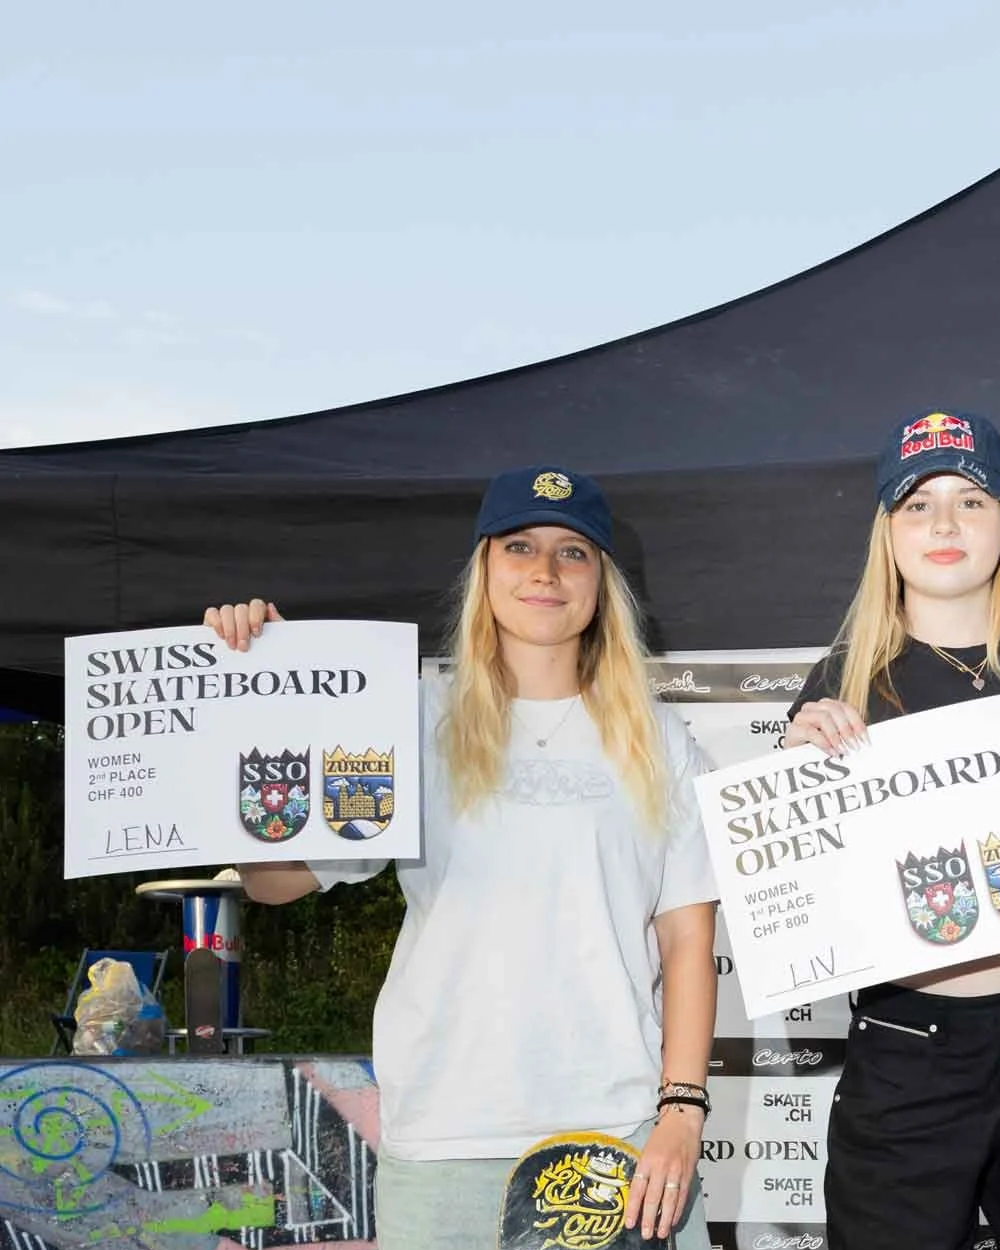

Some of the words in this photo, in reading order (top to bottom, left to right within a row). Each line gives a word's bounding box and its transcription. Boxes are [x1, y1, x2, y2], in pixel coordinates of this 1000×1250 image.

[901, 432, 936, 460] Red
[937, 431, 975, 453] Bull
[87, 642, 217, 677] SWISS
[87, 669, 367, 709] SKATEBOARD
[740, 674, 806, 692] Cert
[87, 706, 196, 741] OPEN
[751, 720, 790, 734] SKAT
[87, 752, 141, 769] WOMEN
[110, 768, 157, 781] PLACE
[243, 761, 307, 782] SSO
[719, 753, 852, 813] SWISS
[88, 789, 116, 802] CHF
[119, 786, 143, 799] 400
[104, 823, 185, 855] LENA
[735, 822, 848, 877] OPEN
[903, 856, 966, 889] SSO
[744, 880, 799, 905] WOMEN
[767, 893, 816, 917] PLACE
[752, 921, 781, 939] CHF
[785, 912, 810, 930] 800
[789, 946, 838, 988] LIV
[752, 1048, 823, 1067] Certo
[763, 1094, 811, 1107] SKATE
[785, 1109, 812, 1122] .CH
[744, 1141, 819, 1161] OPEN
[763, 1178, 813, 1191] SKATE
[785, 1193, 813, 1206] .CH
[753, 1232, 823, 1250] Certo
